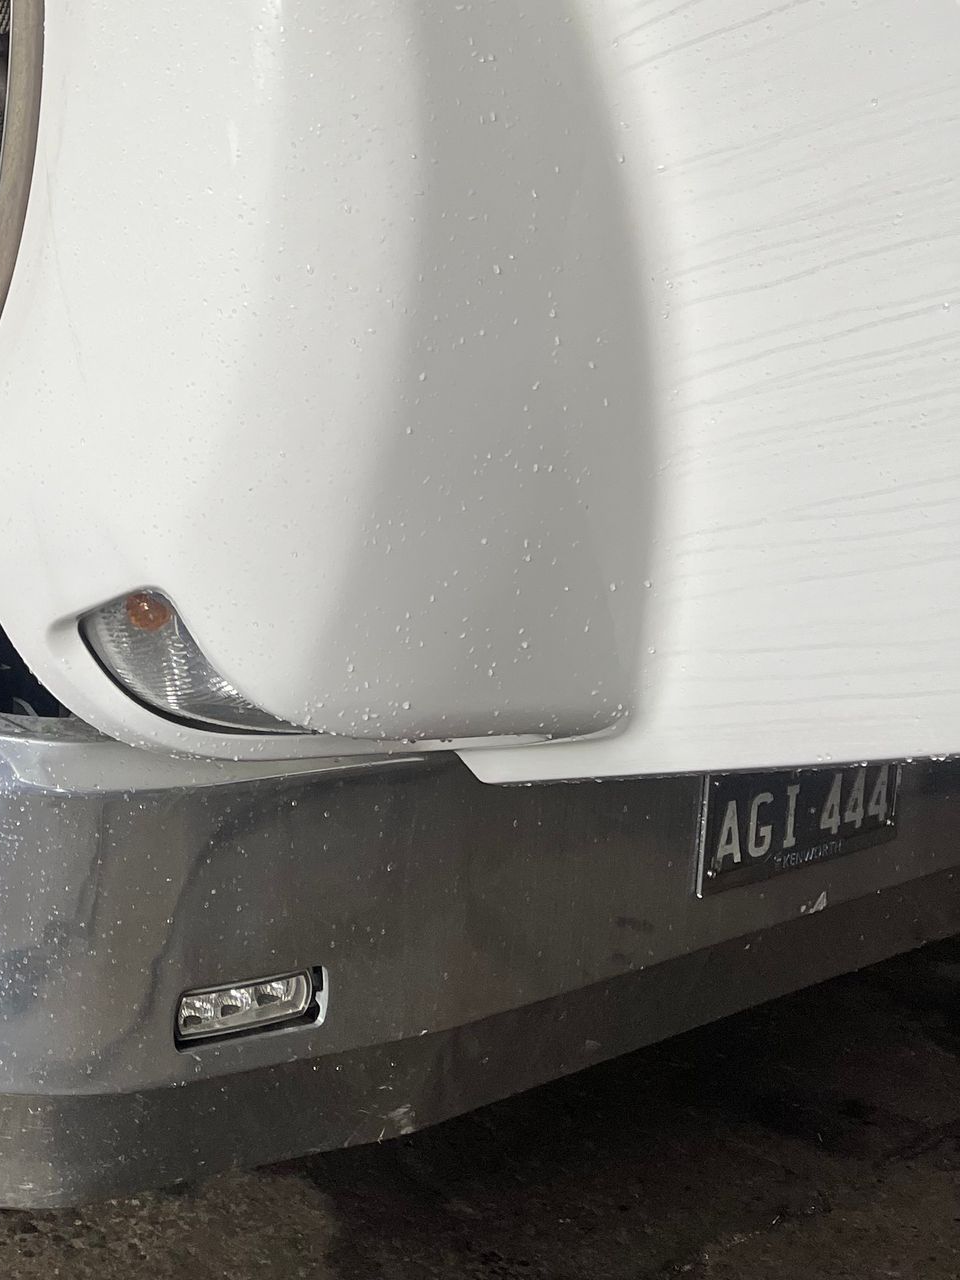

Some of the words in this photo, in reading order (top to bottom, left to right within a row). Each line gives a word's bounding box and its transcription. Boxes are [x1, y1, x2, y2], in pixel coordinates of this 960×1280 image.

[716, 784, 800, 863] AGI
[820, 765, 889, 834] 444
[782, 840, 843, 868] KENWORTH
